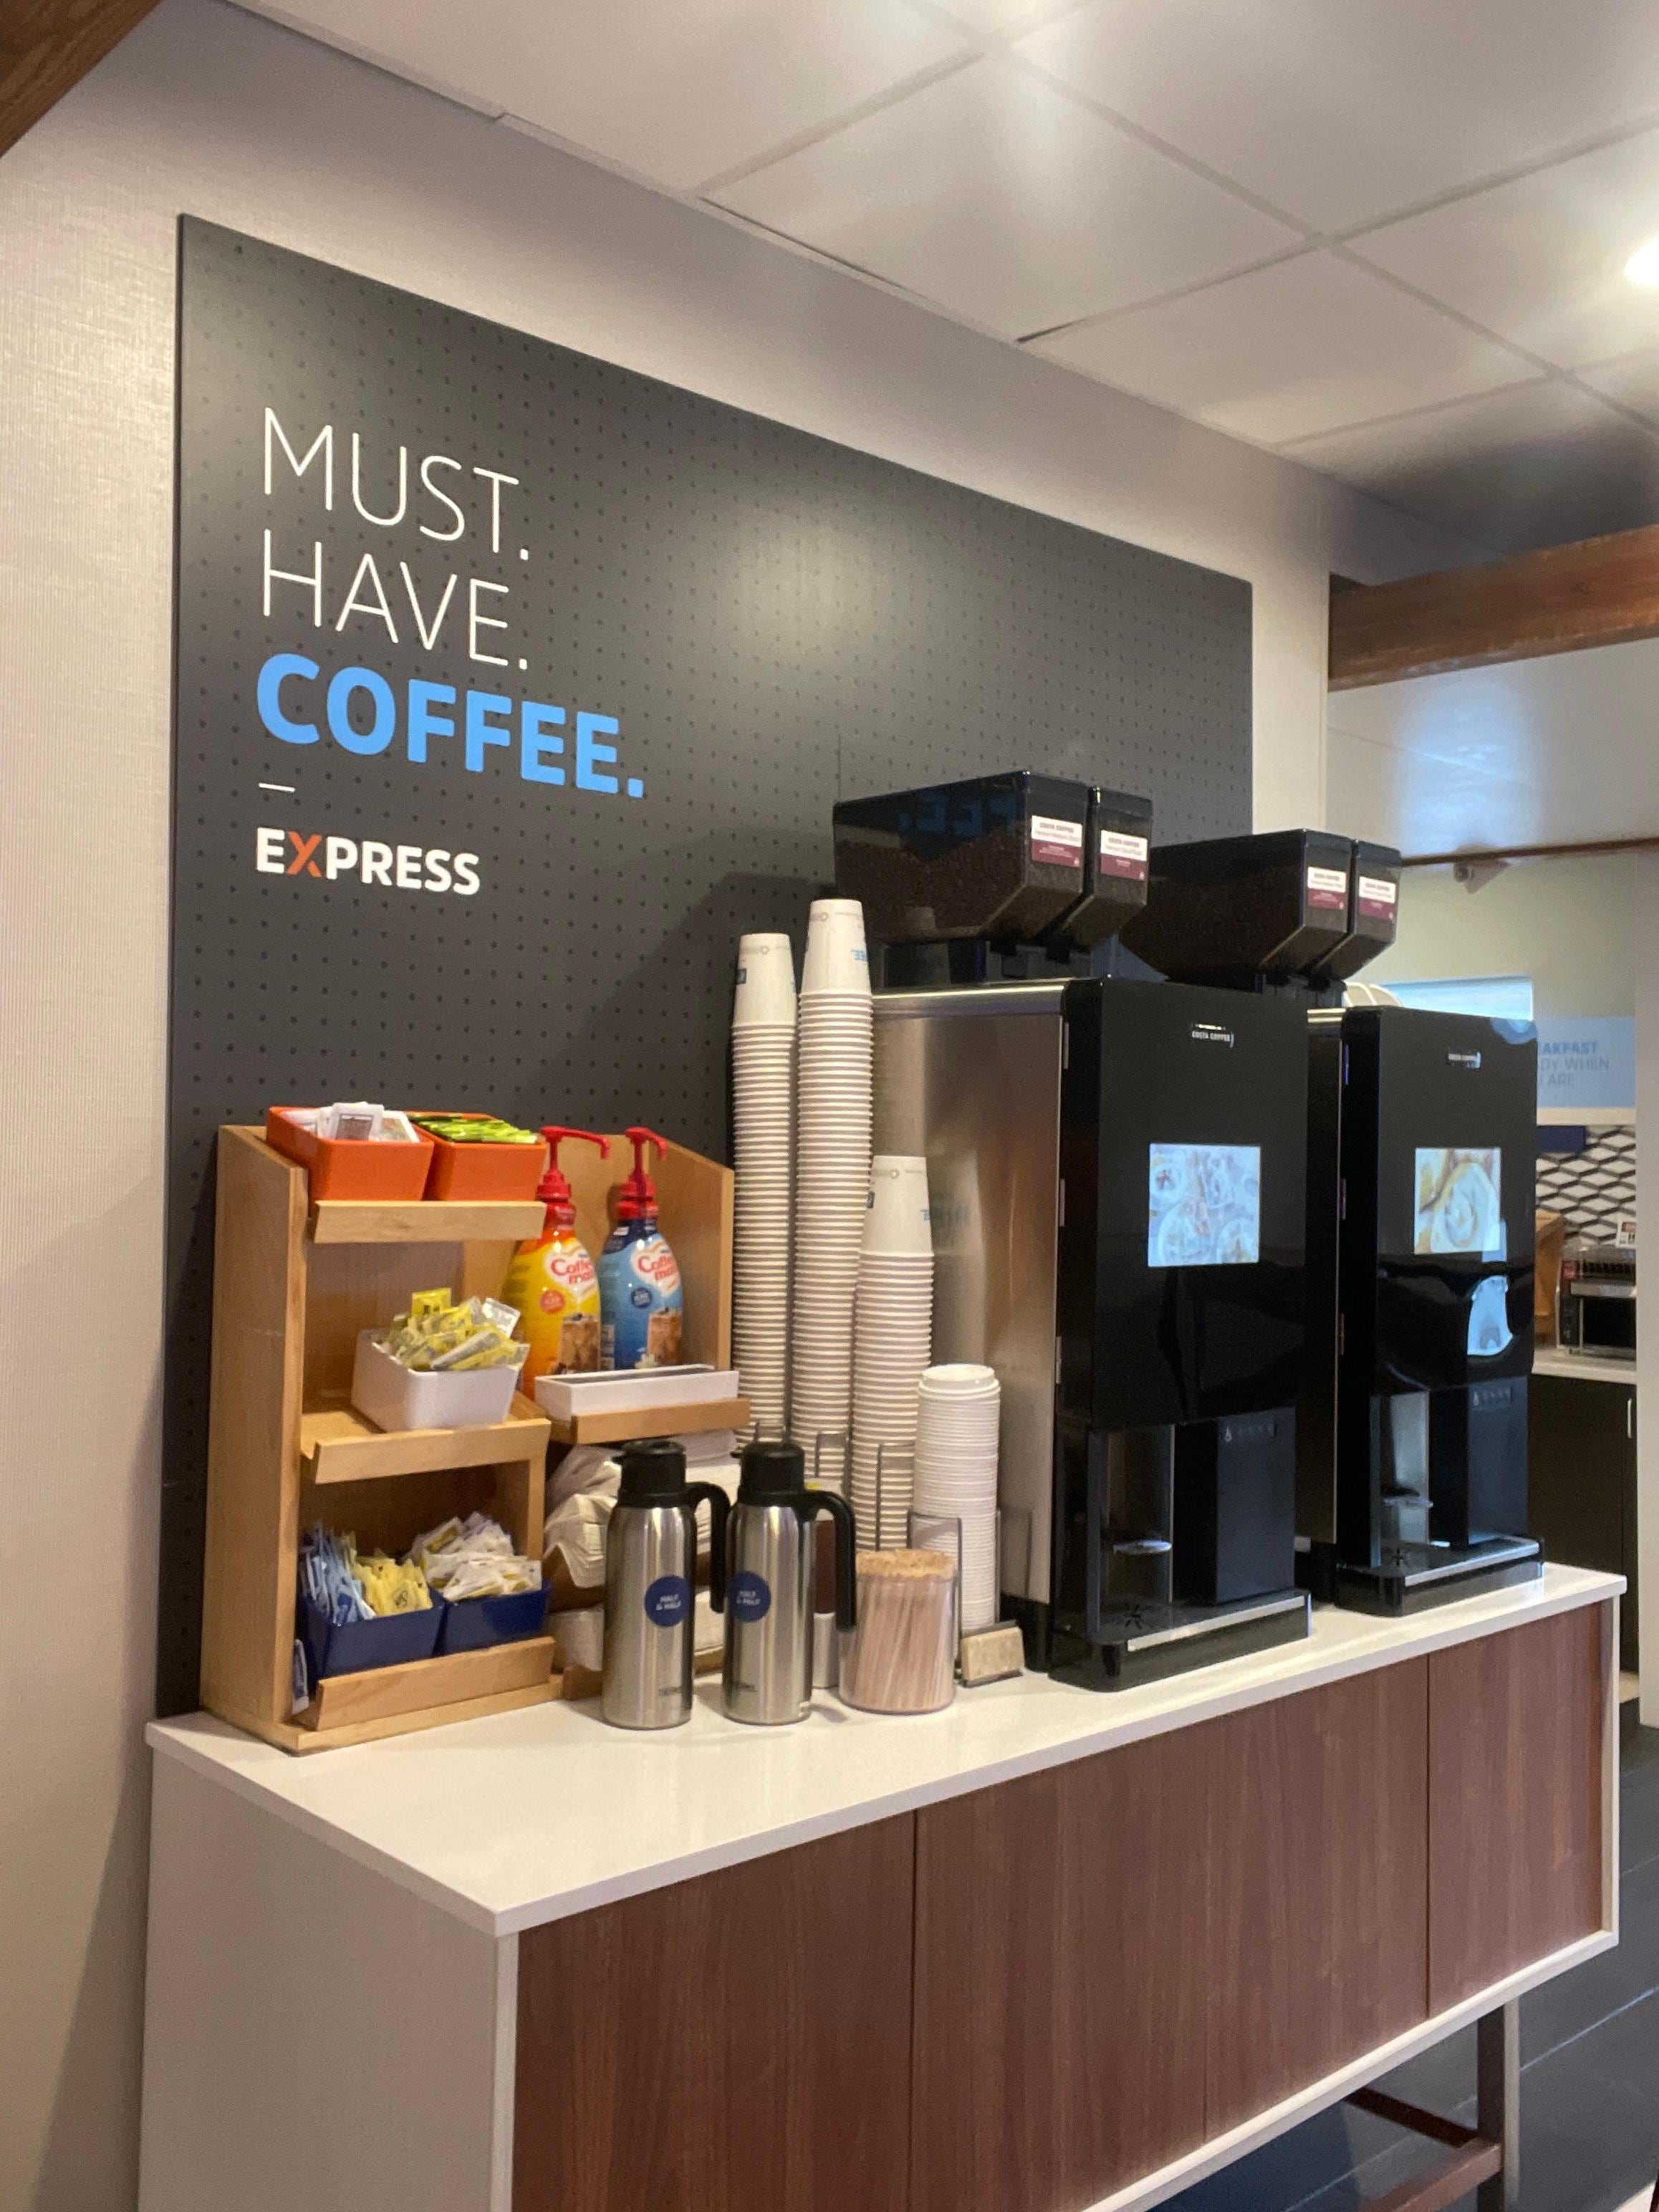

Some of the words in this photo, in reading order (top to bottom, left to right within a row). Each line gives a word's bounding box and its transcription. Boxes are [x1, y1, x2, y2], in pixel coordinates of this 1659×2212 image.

[263, 406, 530, 561] MUST.
[262, 528, 529, 670] HAVE.
[256, 653, 645, 799] COFFEE.
[256, 827, 481, 895] EXPRESS
[1564, 1056, 1610, 1072] WHEN
